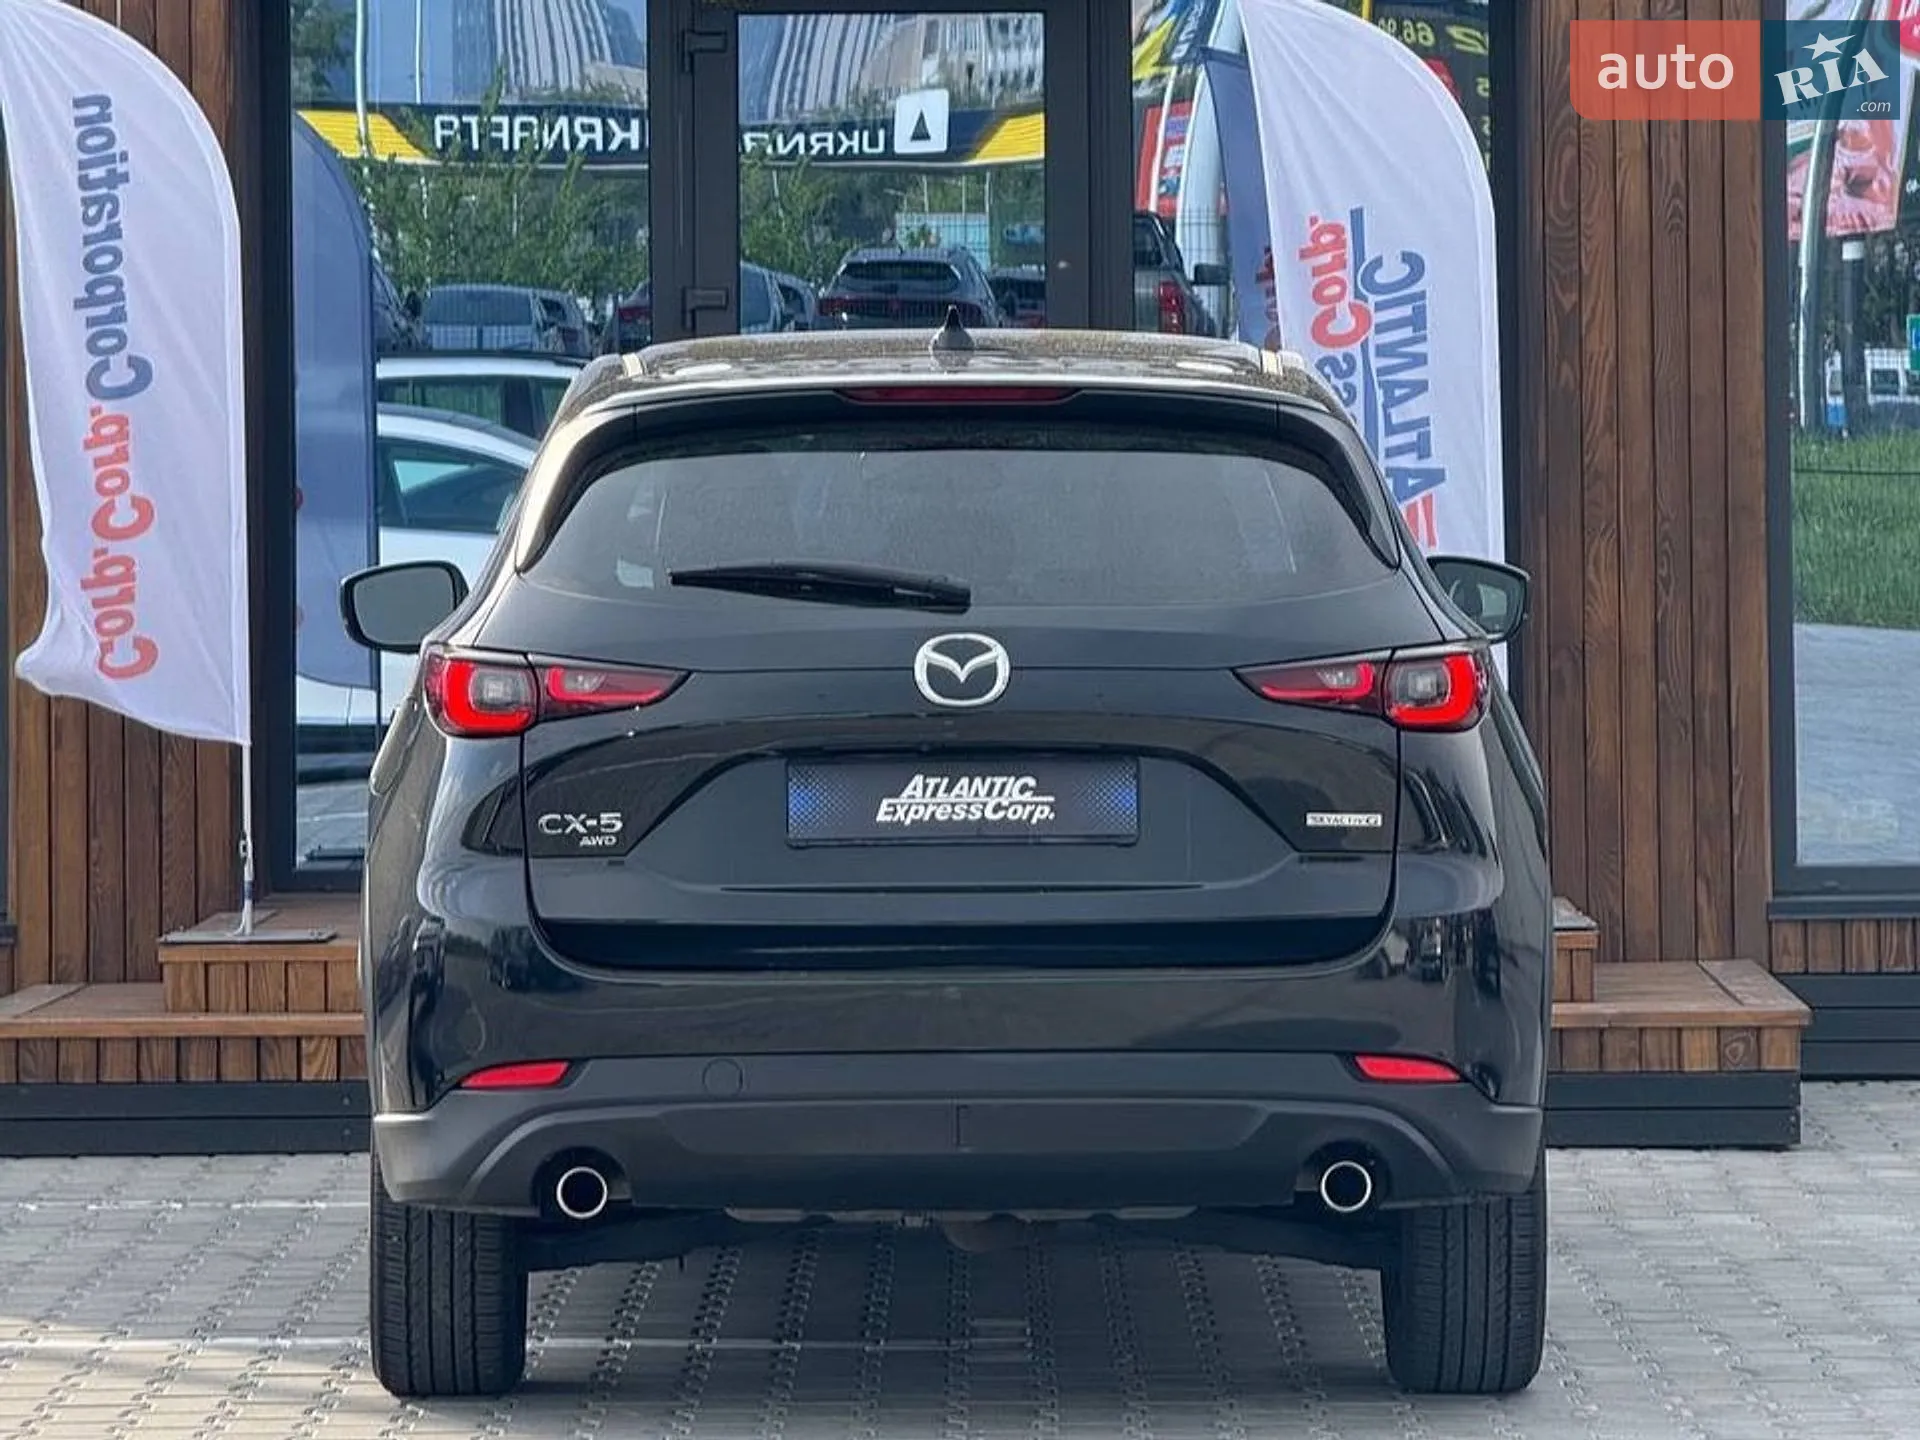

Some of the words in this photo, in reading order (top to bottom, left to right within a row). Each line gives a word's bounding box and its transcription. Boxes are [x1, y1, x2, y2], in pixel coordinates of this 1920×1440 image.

[900, 773, 1037, 801] ATLANTIC
[538, 812, 624, 834] CX-5
[876, 799, 1056, 825] ExpressCorp.
[580, 835, 617, 847] AWD
